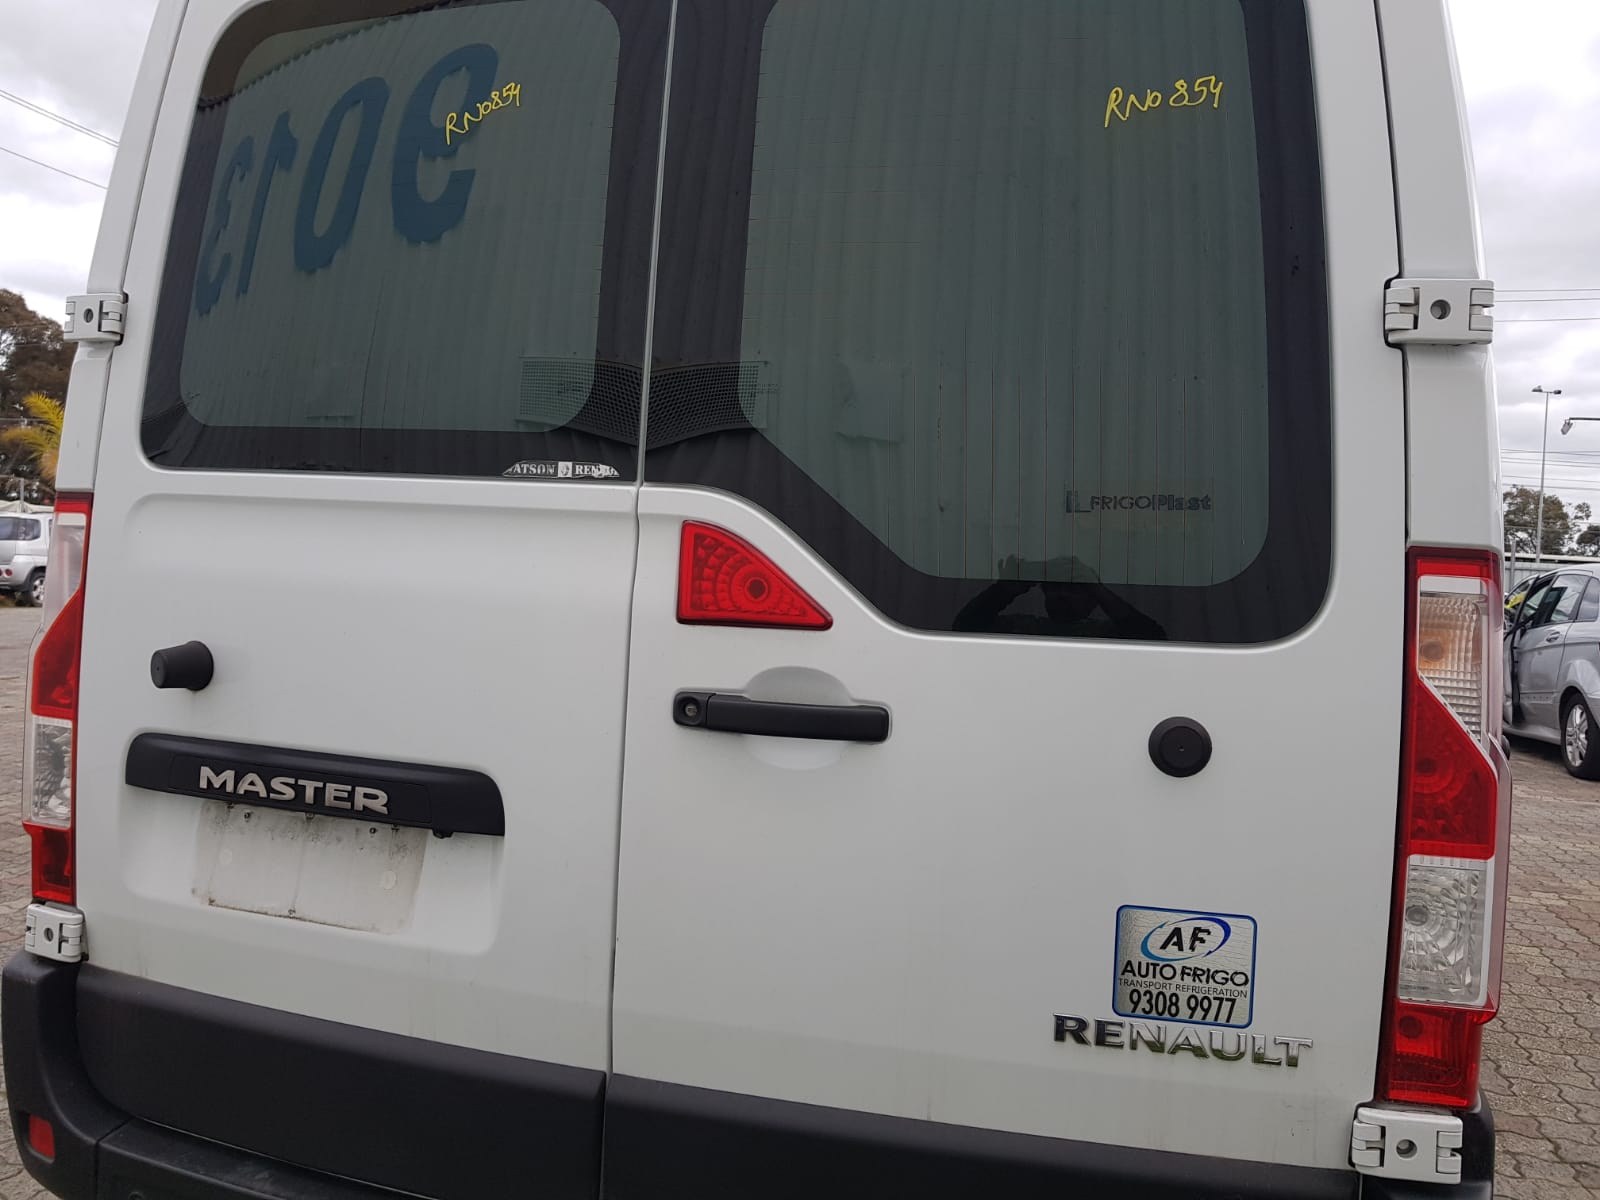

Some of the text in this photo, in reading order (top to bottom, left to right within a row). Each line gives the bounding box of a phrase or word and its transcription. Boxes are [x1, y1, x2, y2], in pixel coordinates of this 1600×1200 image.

[1168, 75, 1224, 109] 854
[199, 765, 389, 815] MASTER
[1159, 926, 1212, 953] AF
[1119, 977, 1248, 999] TRANSPORT REFRIGERATION
[1120, 959, 1250, 987] AUTO FRIGO
[1129, 988, 1237, 1024] 9308 9977
[1052, 1012, 1314, 1068] RENAULT
